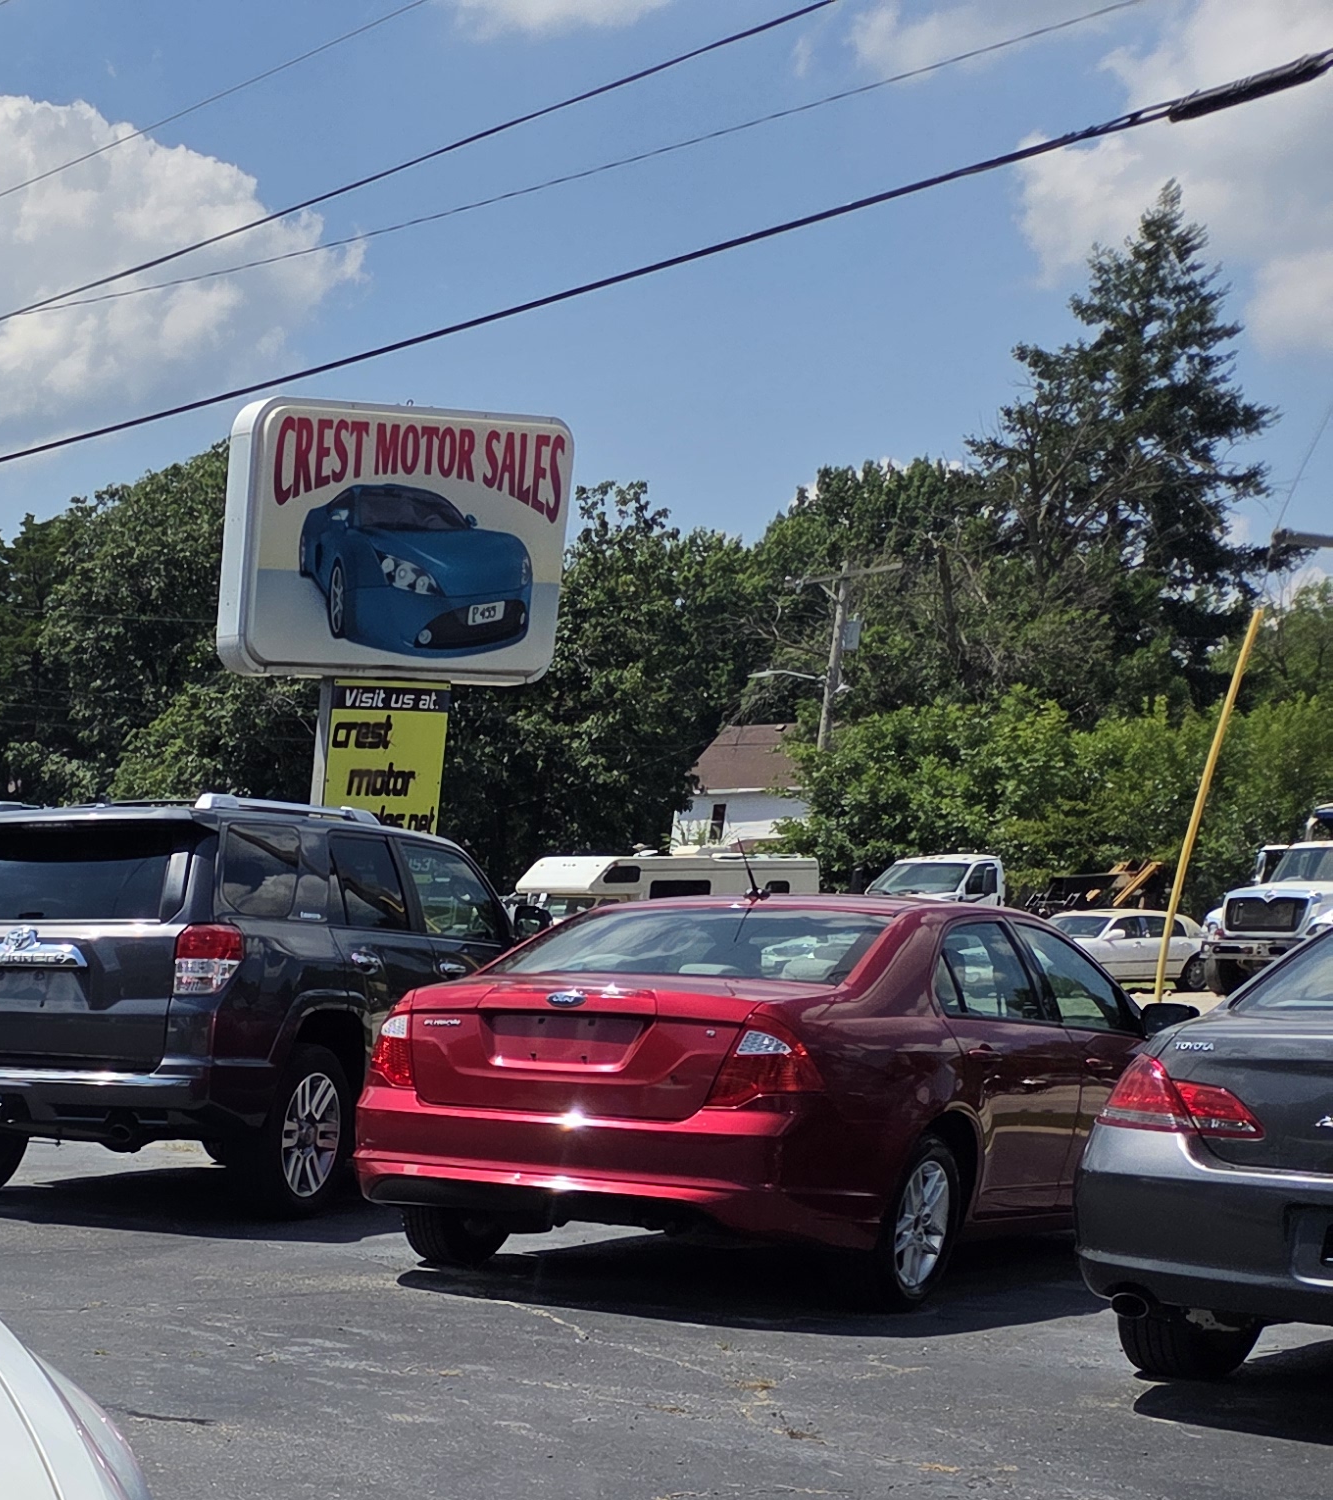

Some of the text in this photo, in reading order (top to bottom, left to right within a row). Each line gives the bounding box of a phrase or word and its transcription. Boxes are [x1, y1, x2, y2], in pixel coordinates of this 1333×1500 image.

[273, 416, 566, 525] CREST MOTOR SALES
[345, 689, 386, 708] Visit
[390, 693, 415, 709] us
[331, 714, 393, 750] crest
[346, 762, 416, 797] motor
[1175, 1041, 1214, 1051] TOYOTA
